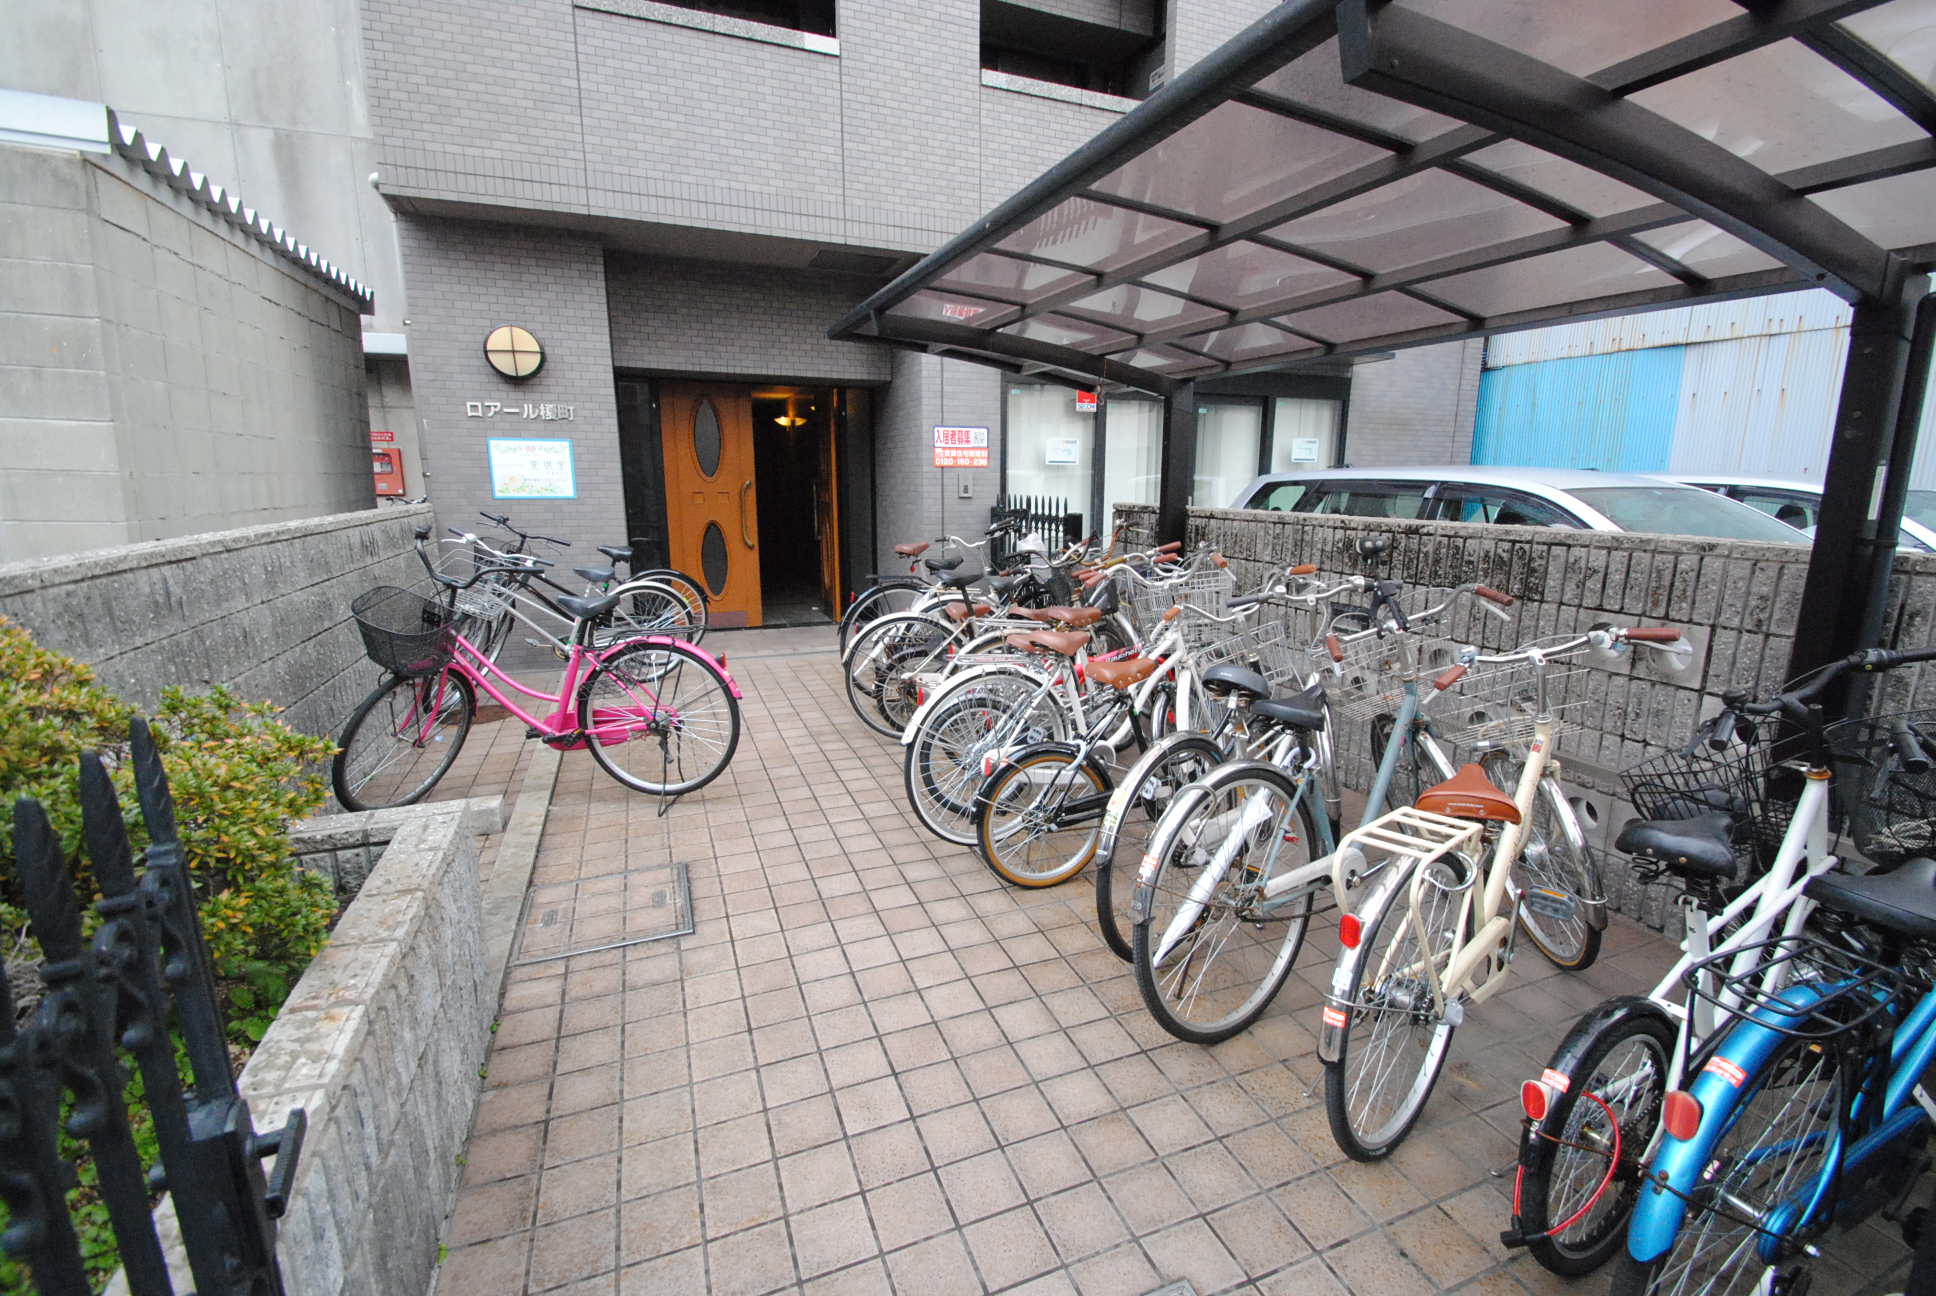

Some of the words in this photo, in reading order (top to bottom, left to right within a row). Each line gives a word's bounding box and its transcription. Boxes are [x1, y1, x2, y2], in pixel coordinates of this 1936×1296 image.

[935, 429, 971, 446] 入居者募集
